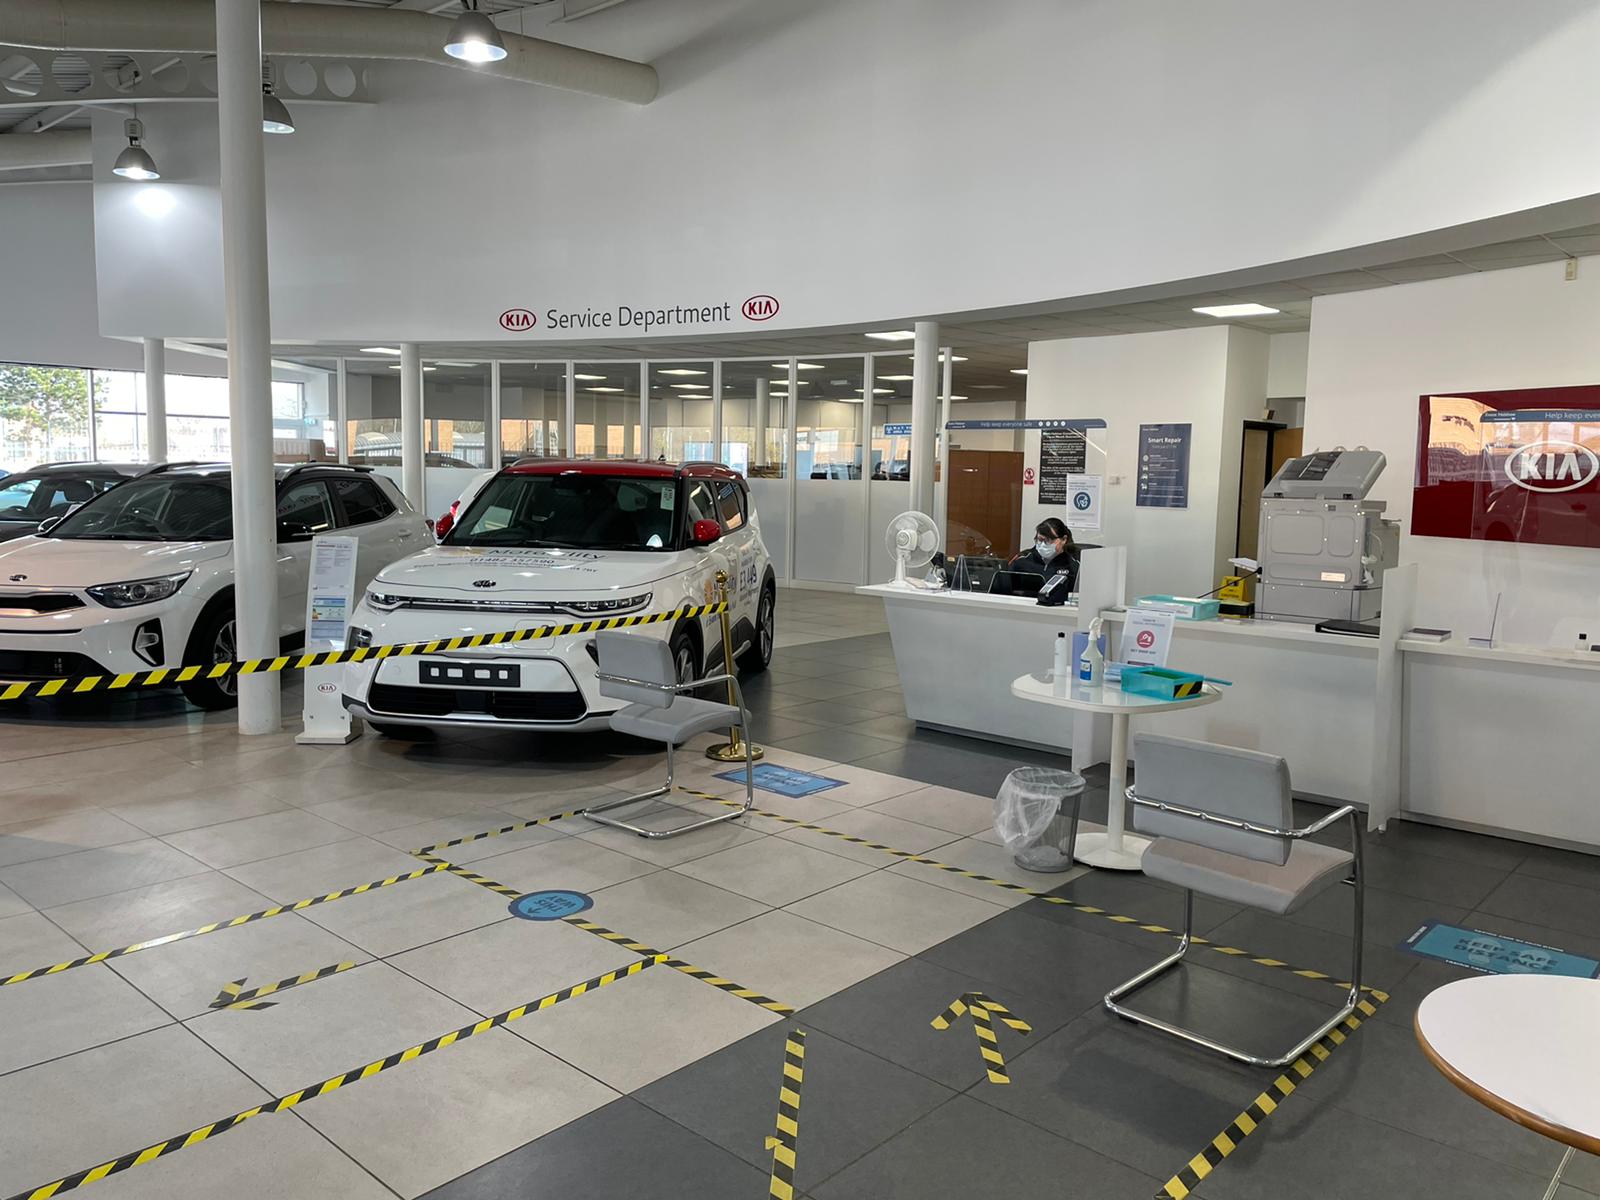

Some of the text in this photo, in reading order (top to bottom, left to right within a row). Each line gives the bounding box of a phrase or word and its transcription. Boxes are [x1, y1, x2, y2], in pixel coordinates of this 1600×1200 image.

[546, 302, 731, 332] Service Department
[1544, 412, 1563, 420] Help
[1564, 412, 1582, 420] keep
[1453, 943, 1554, 971] DISTANCE
[1458, 938, 1505, 951] KEEP
[1511, 950, 1559, 966] SAFE
